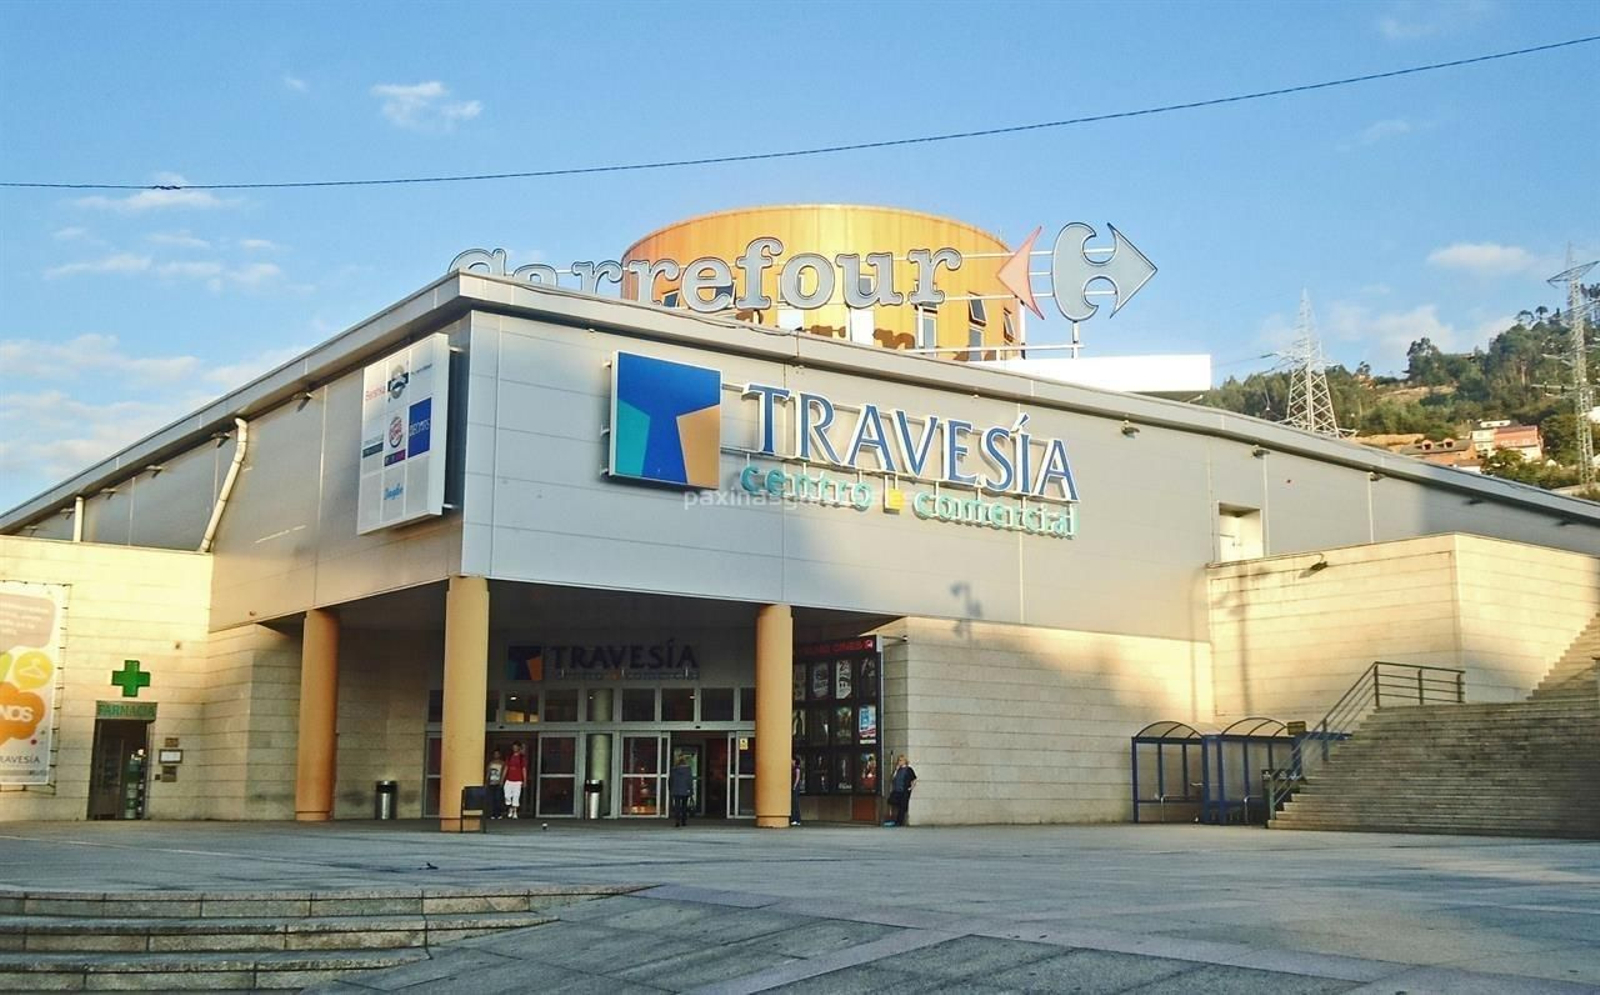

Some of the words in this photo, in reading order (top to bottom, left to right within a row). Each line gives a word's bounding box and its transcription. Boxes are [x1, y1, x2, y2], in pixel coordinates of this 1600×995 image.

[741, 383, 1081, 503] TRAVESÍA
[740, 464, 873, 512] centro
[912, 490, 1080, 541] comercial
[550, 637, 700, 670] TRAVESÍA
[98, 704, 155, 718] FARMACIA
